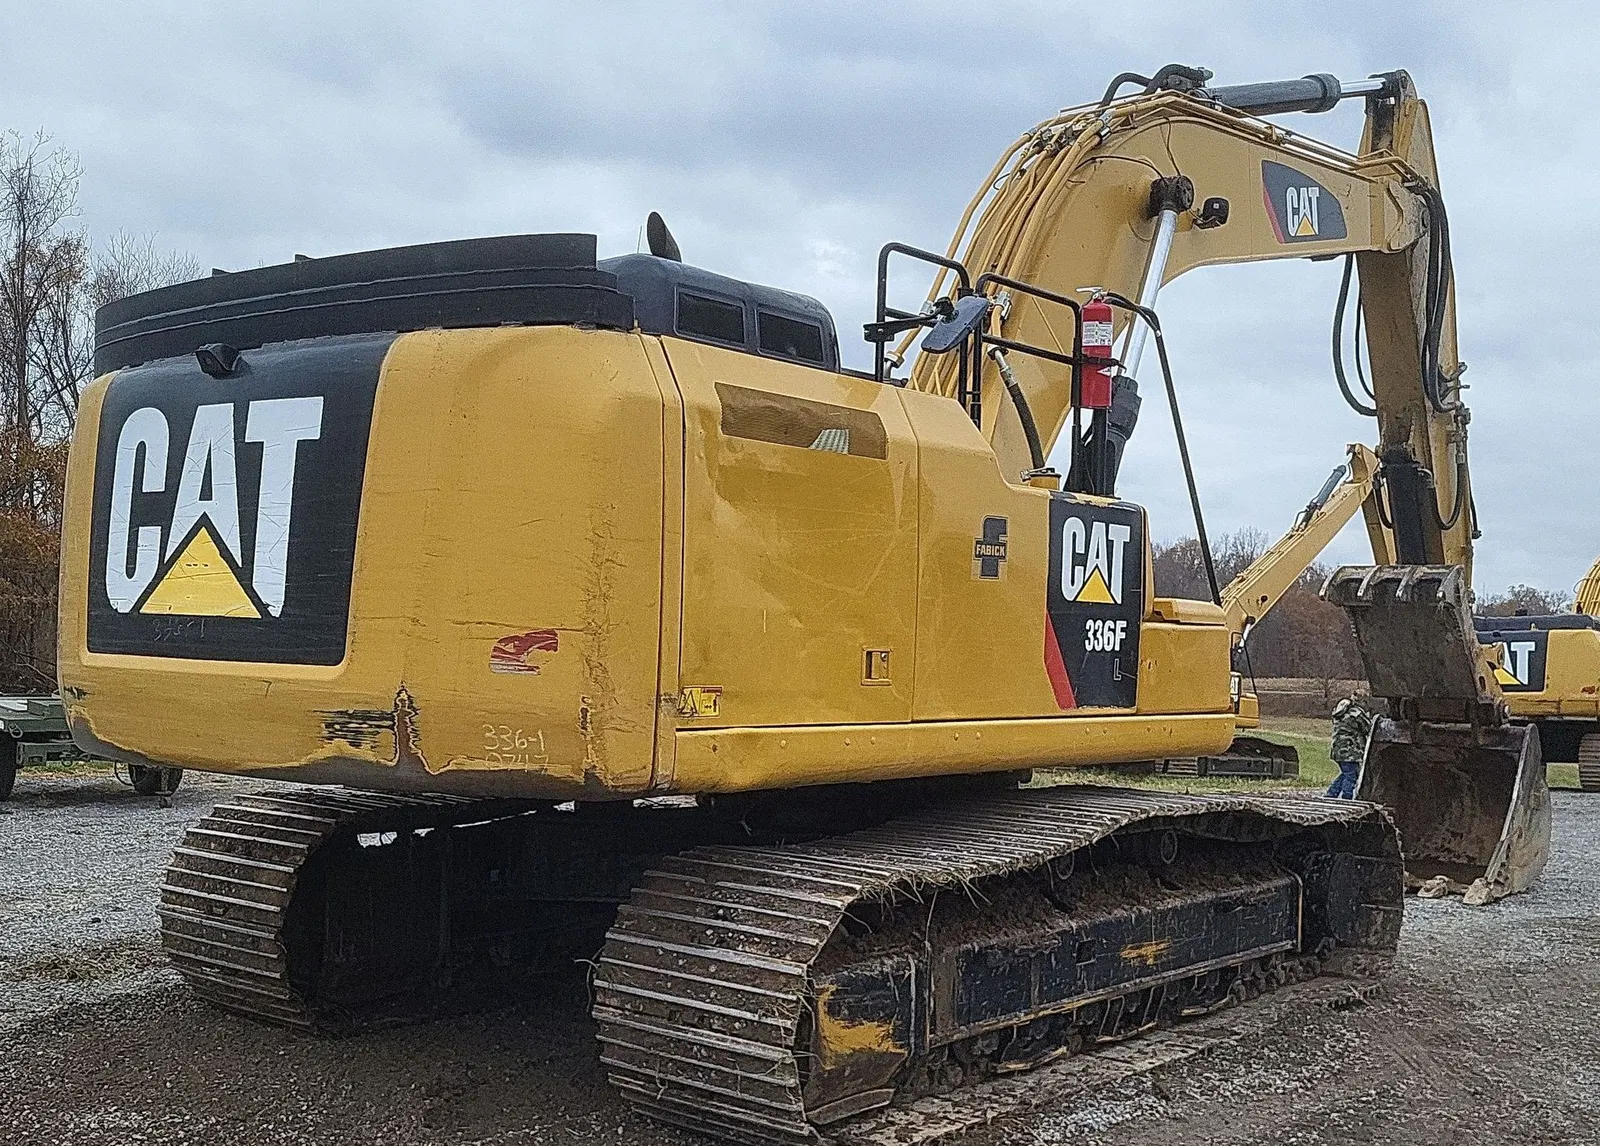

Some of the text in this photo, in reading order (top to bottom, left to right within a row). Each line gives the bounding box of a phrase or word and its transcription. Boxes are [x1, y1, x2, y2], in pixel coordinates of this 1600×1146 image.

[1285, 186, 1320, 237] CAT
[105, 396, 325, 618] CAT
[975, 543, 1006, 557] FABICK
[1060, 516, 1131, 605] CAT
[1084, 618, 1128, 652] 336F
